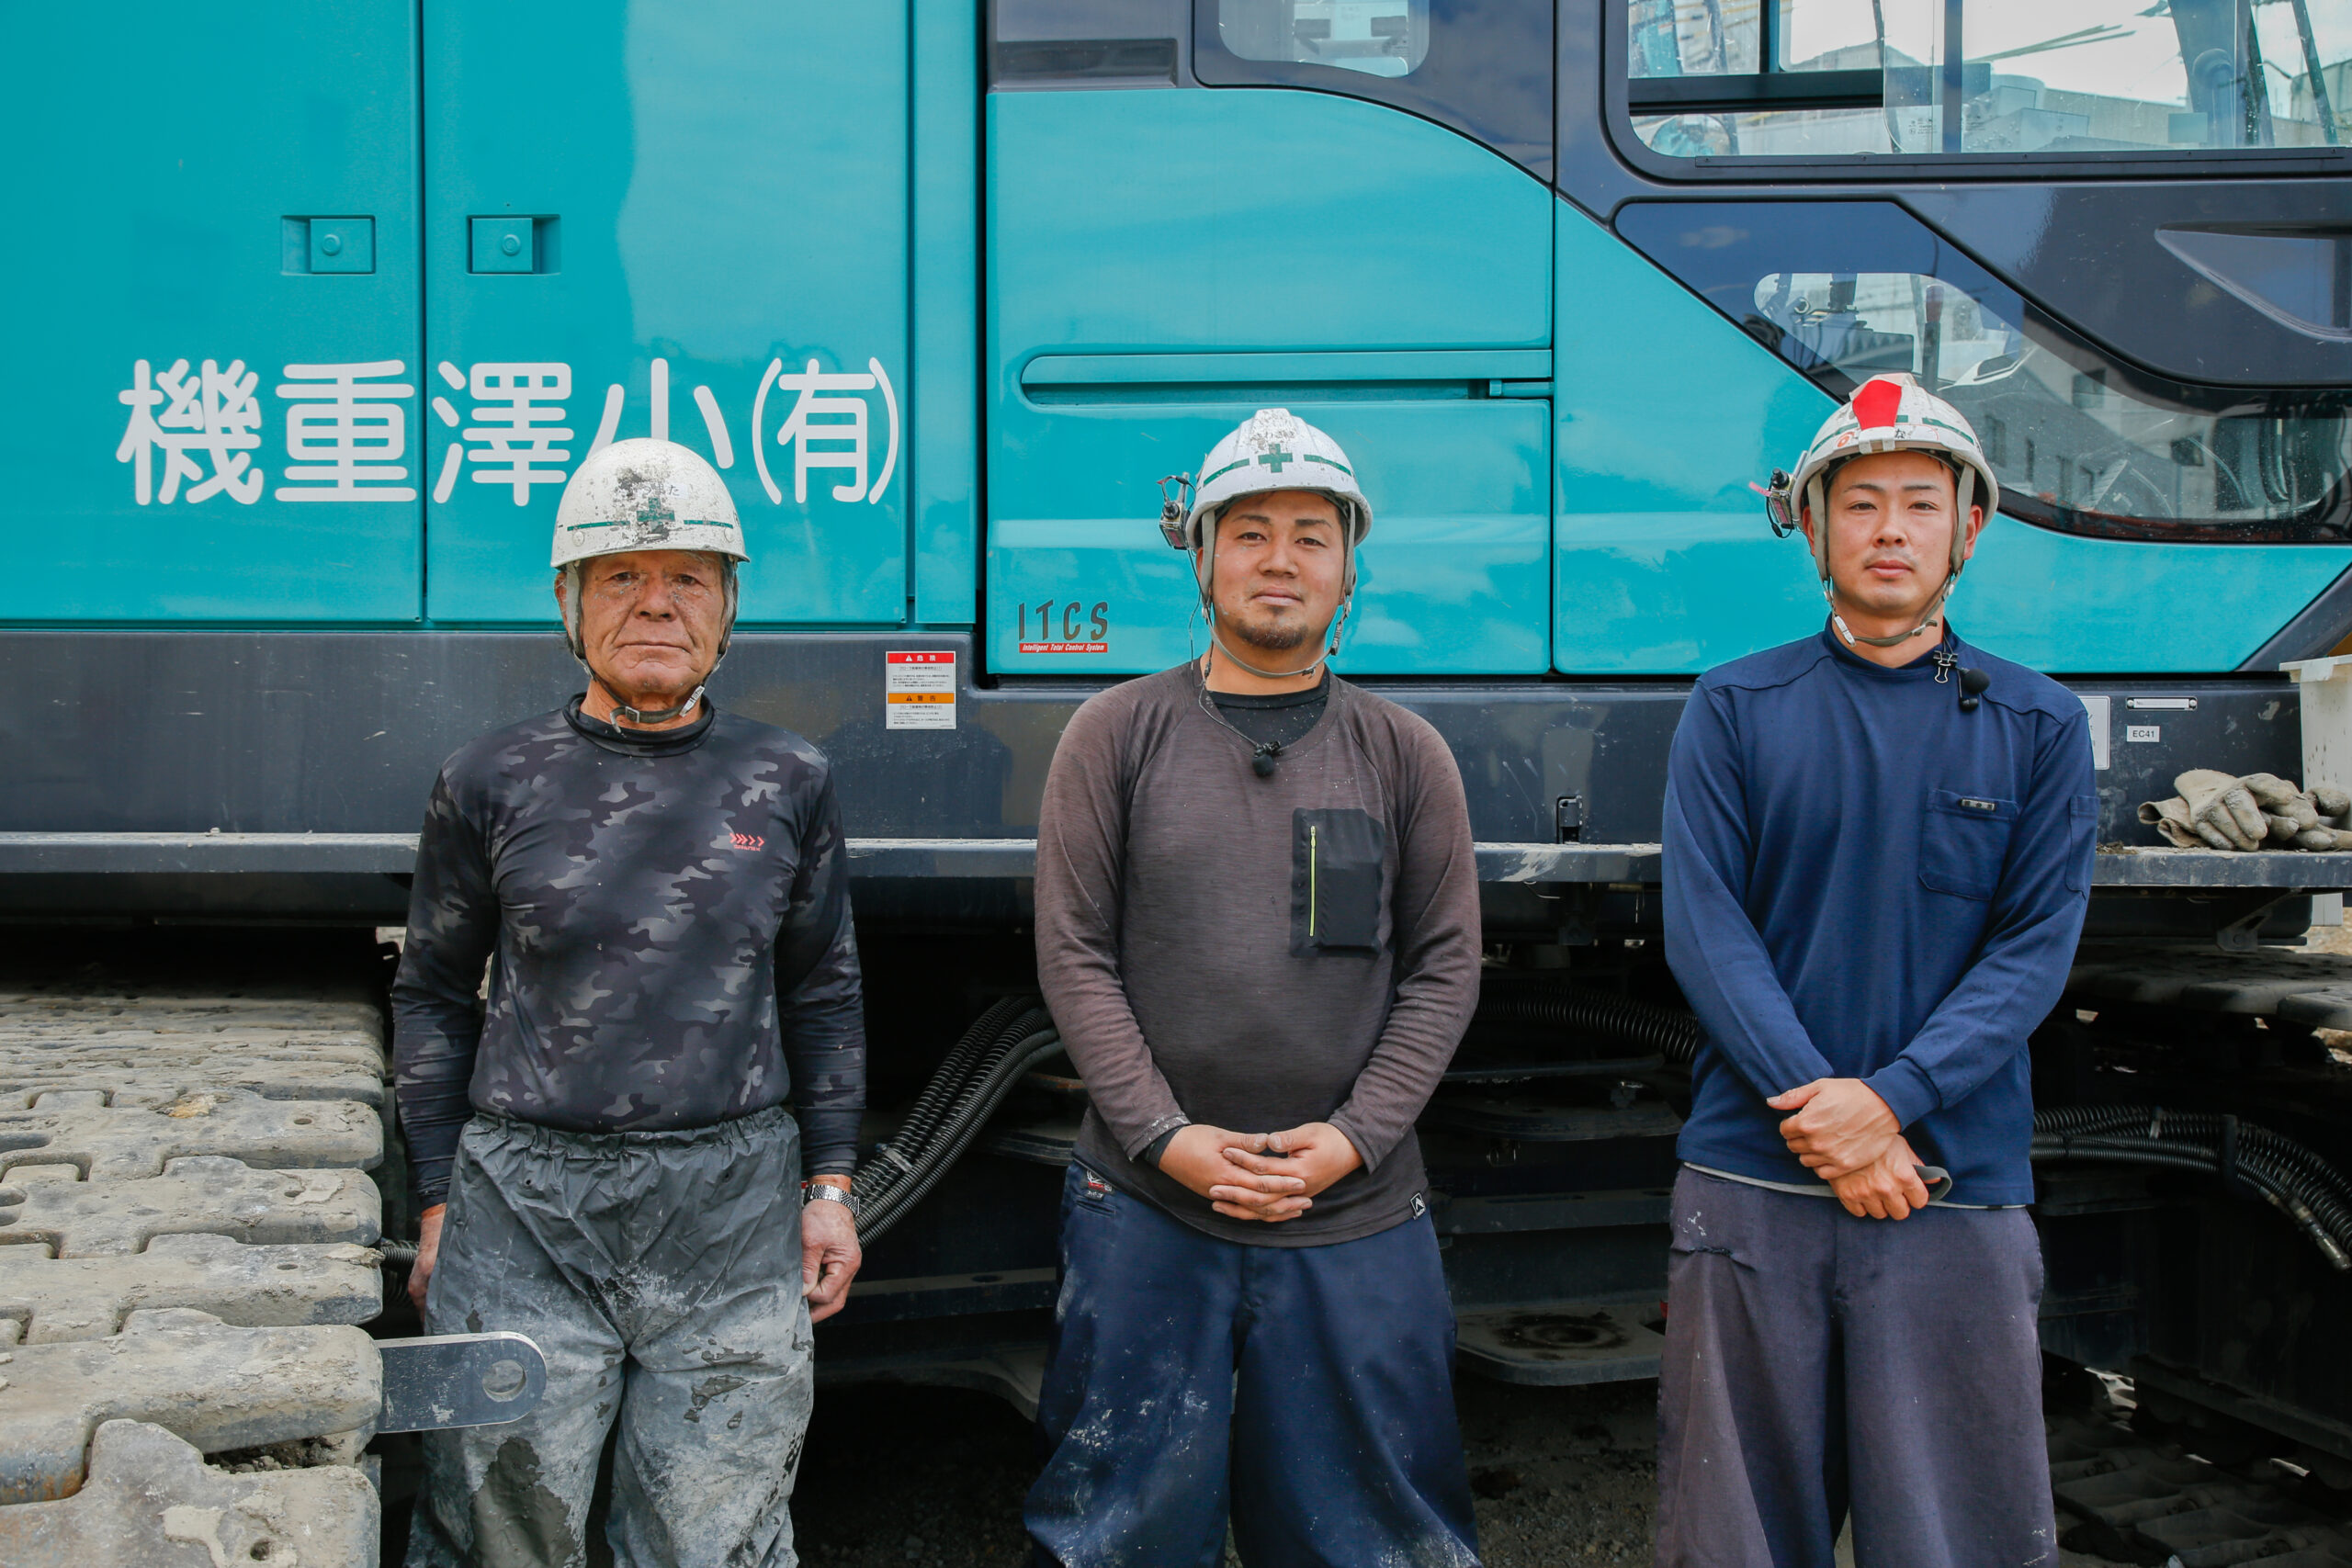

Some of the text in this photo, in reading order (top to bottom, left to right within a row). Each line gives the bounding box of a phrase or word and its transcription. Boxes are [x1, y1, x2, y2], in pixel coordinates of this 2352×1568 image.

[1018, 599, 1108, 641] ITCS
[1022, 644, 1049, 653] Intelligent
[1086, 644, 1105, 652] System
